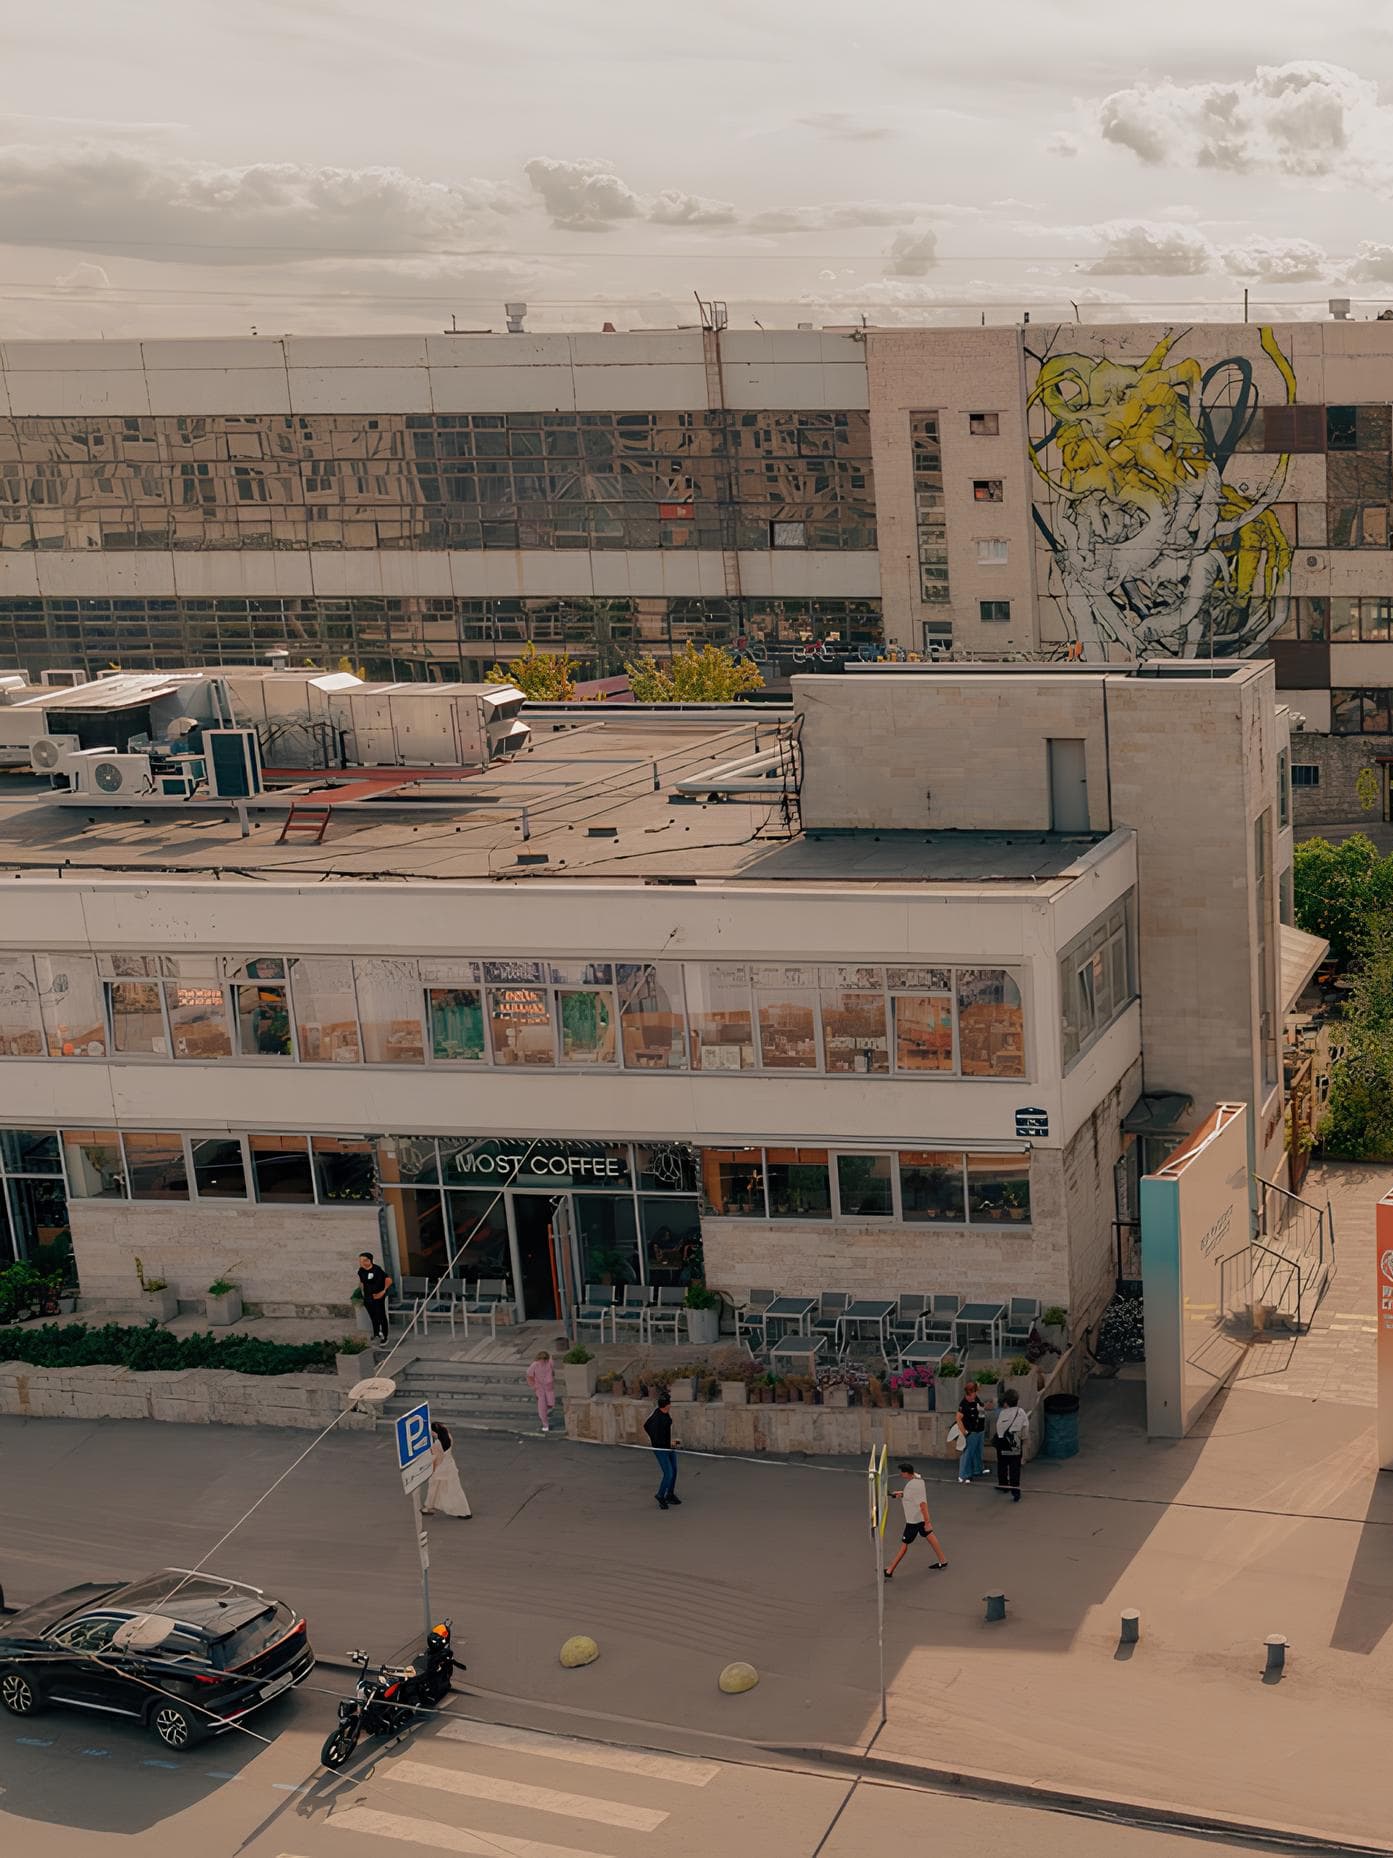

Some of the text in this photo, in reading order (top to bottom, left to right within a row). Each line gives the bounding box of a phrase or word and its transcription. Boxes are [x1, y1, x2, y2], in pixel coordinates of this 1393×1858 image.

[455, 1154, 620, 1177] MOST COFFEE
[405, 1414, 424, 1457] P
